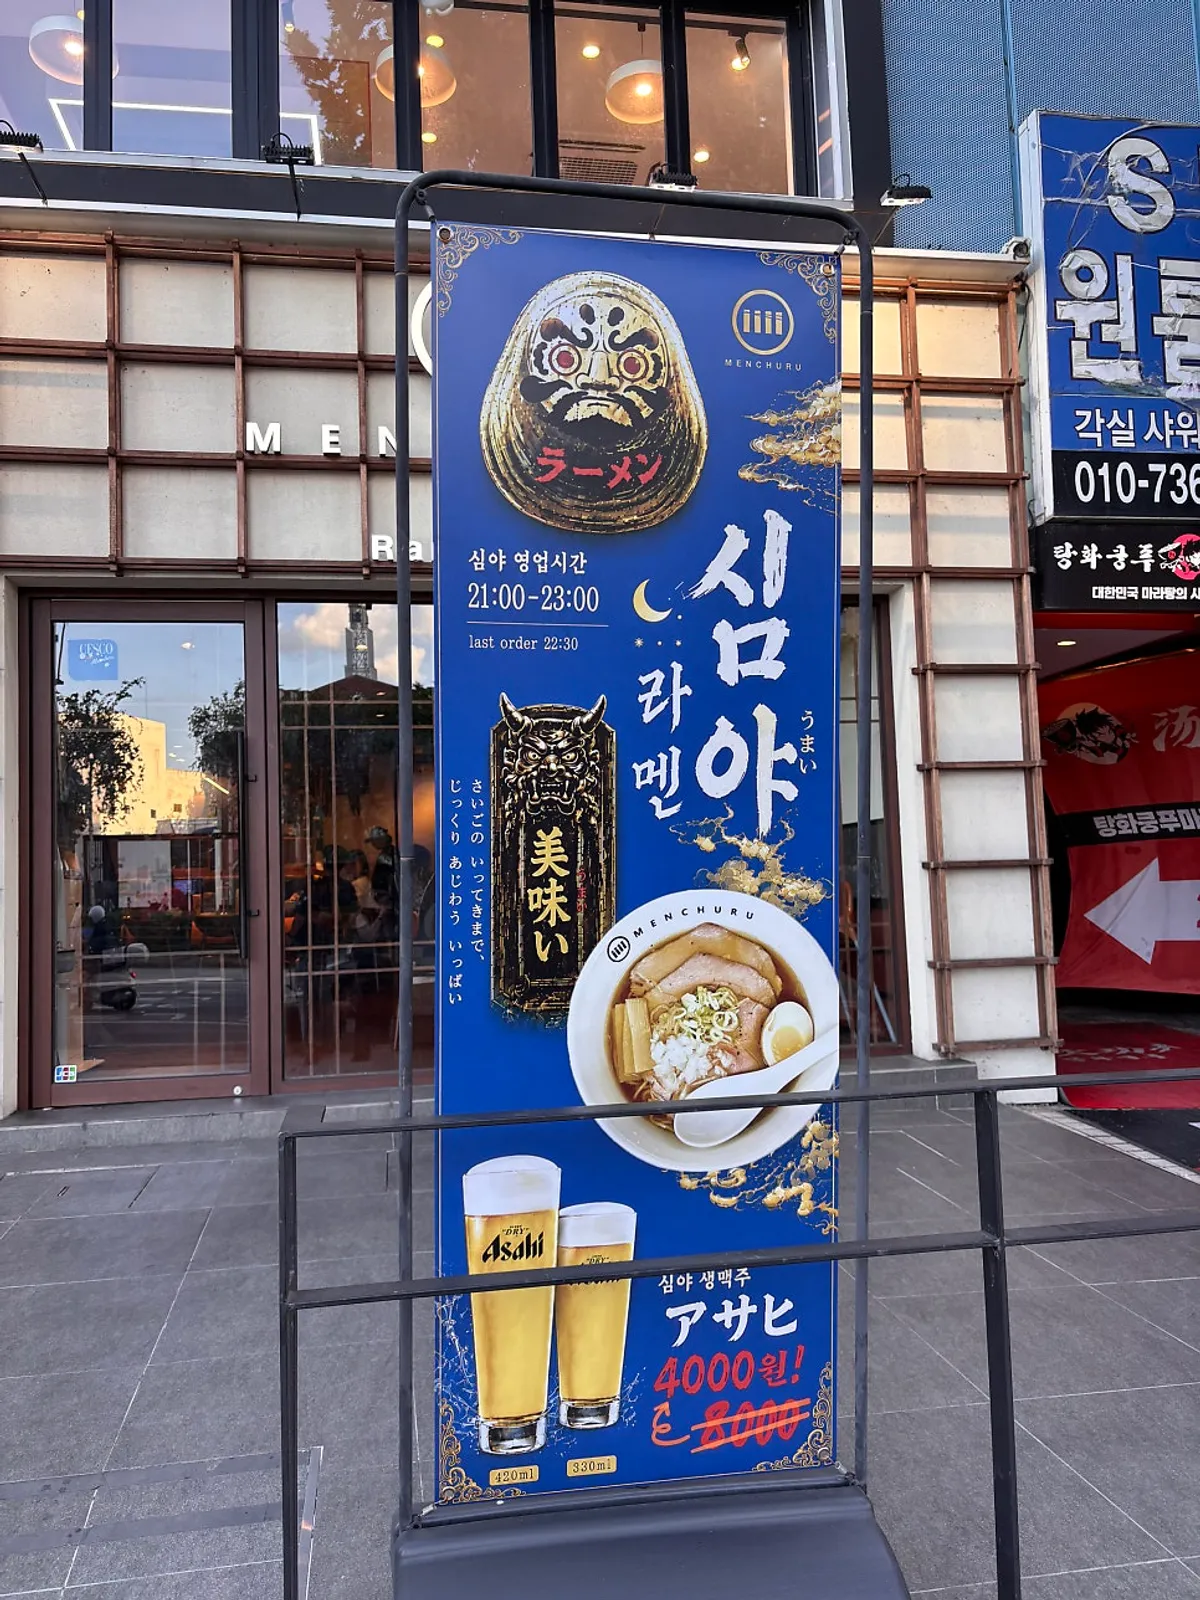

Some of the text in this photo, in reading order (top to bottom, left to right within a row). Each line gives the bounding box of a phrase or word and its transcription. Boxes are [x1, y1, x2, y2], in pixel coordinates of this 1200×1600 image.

[725, 358, 802, 371] MENCHURU
[1074, 408, 1136, 448] 각실
[535, 446, 664, 490] ラーメン
[468, 548, 588, 574] 심야 영업시간
[468, 582, 599, 612] 21:00-23:00
[1092, 586, 1138, 600] 대한민국
[469, 634, 579, 651] last order 22:30
[688, 509, 799, 836] 심야
[632, 661, 692, 820] 라멘
[799, 710, 818, 774] うまい
[449, 779, 463, 845] じっくり
[470, 779, 485, 844] さいごの
[448, 856, 463, 926] あじわう
[527, 826, 571, 962] 美味い
[633, 906, 754, 938] MENCHURU
[482, 1231, 544, 1263] Asahi
[658, 1267, 751, 1294] 심야 생맥주
[665, 1293, 798, 1348] アサヒ
[653, 1344, 805, 1399] 4000원!
[701, 1397, 802, 1450] 8000
[495, 1468, 533, 1483] 420ml
[572, 1458, 612, 1473] 330ml
